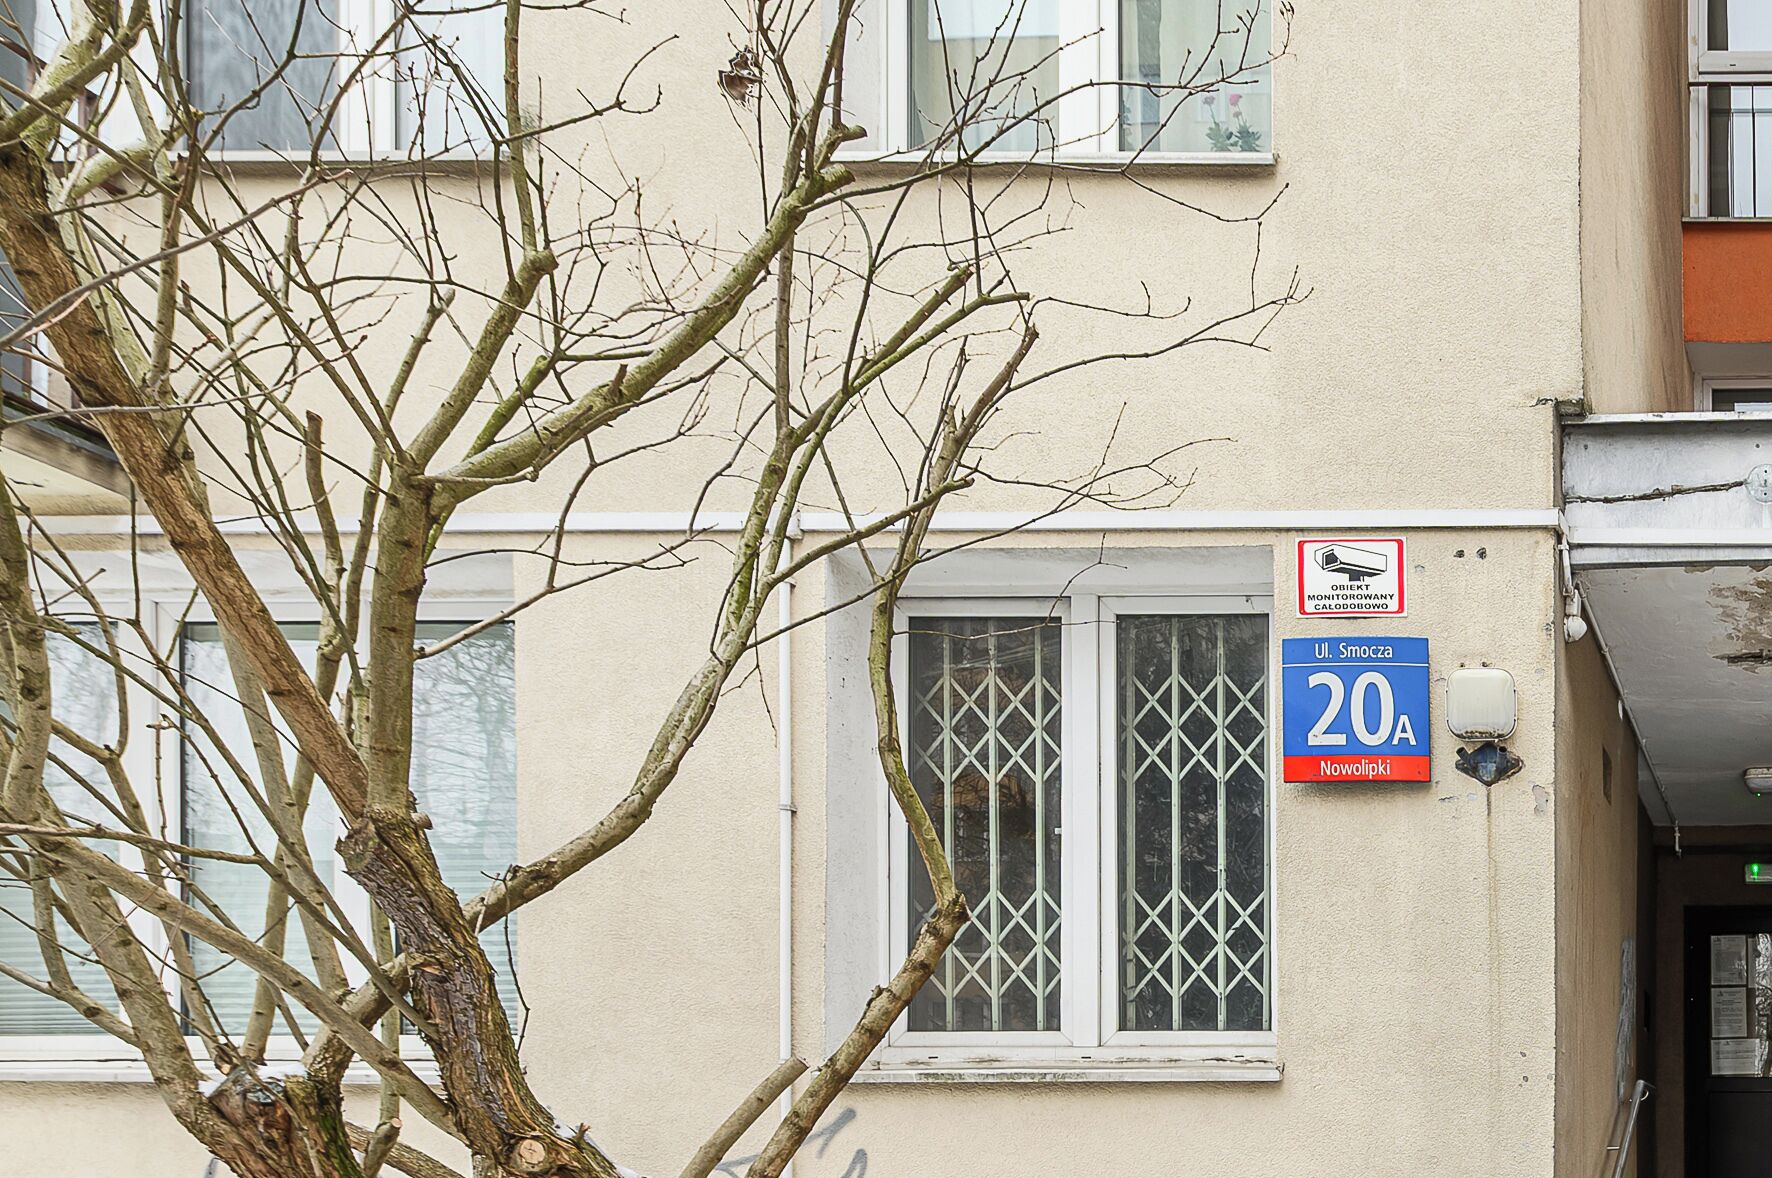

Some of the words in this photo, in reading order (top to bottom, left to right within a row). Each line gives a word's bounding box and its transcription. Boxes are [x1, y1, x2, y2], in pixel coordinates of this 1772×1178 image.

[1307, 593, 1395, 601] MONITOROWANY
[1315, 642, 1333, 659] Ul.
[1339, 642, 1393, 659] Smocza
[1307, 671, 1417, 746] 20A
[1320, 759, 1390, 779] Nowolipki
